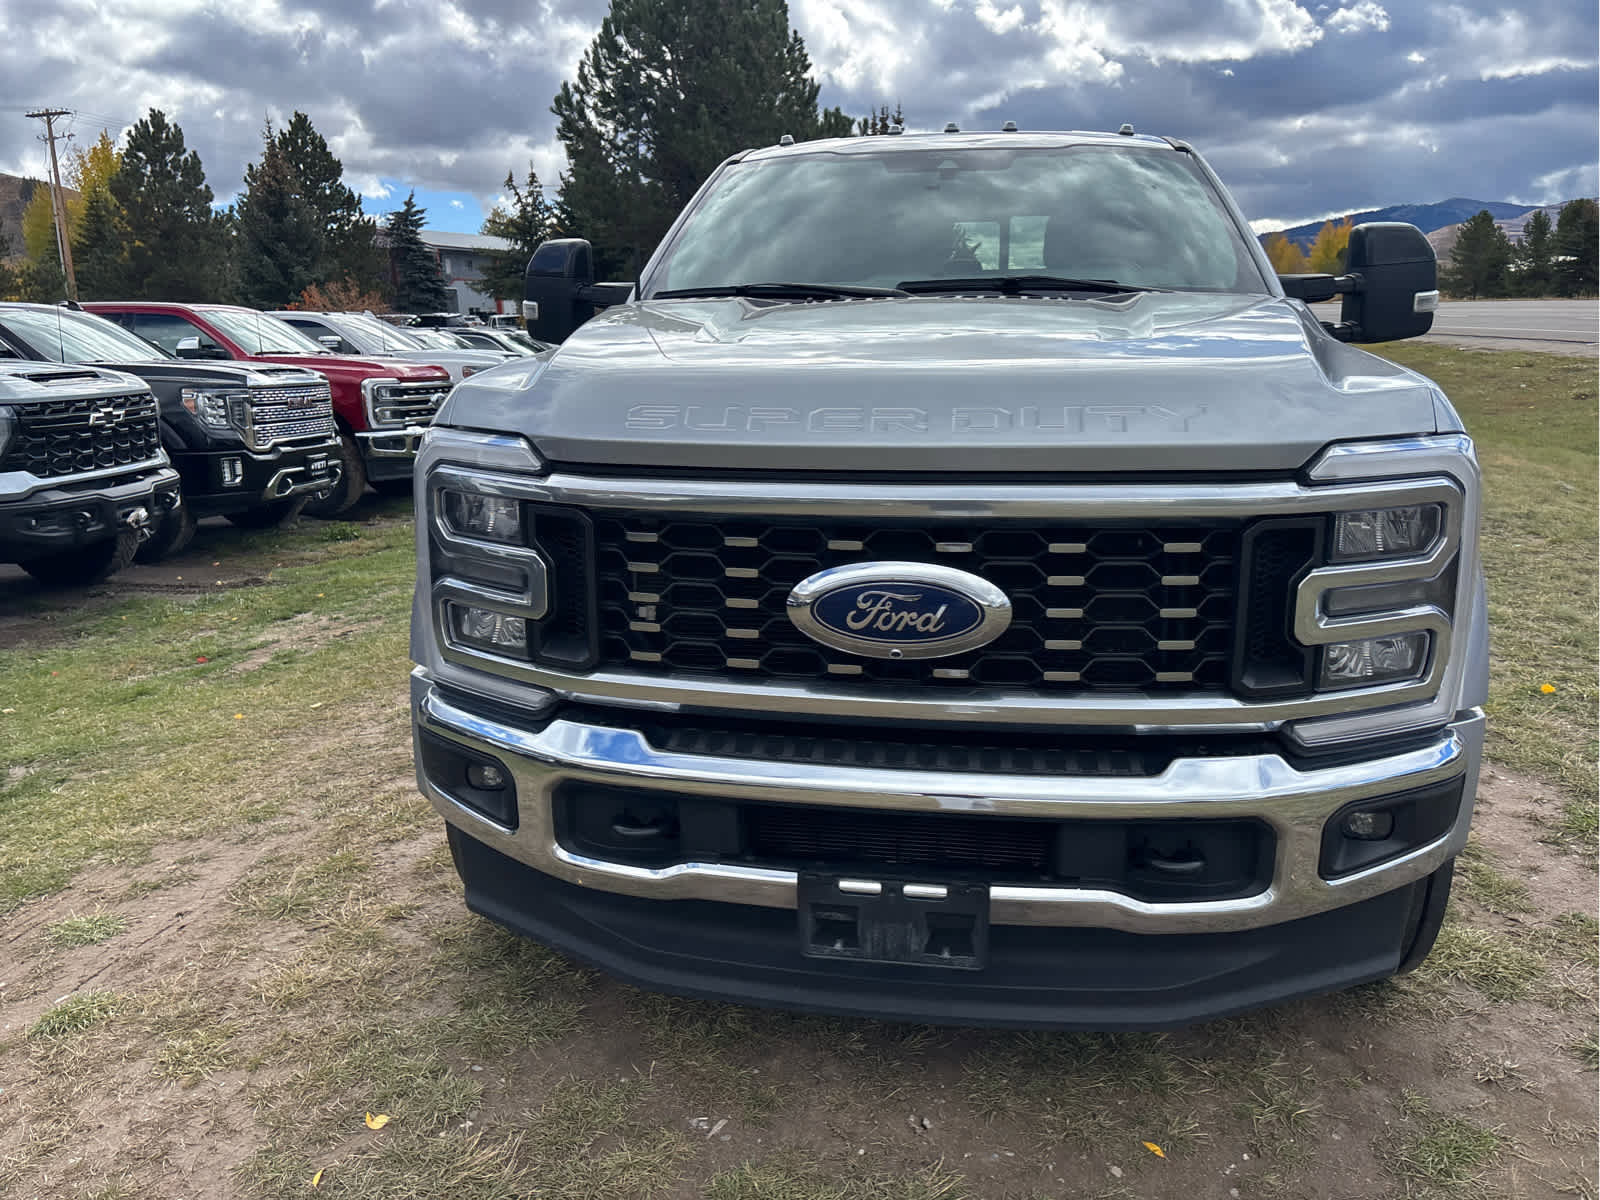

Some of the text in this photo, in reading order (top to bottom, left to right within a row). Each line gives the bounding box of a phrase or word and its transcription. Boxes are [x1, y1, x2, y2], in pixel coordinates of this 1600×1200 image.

[624, 403, 1209, 433] SUPER DUTY
[846, 590, 949, 633] Ford
